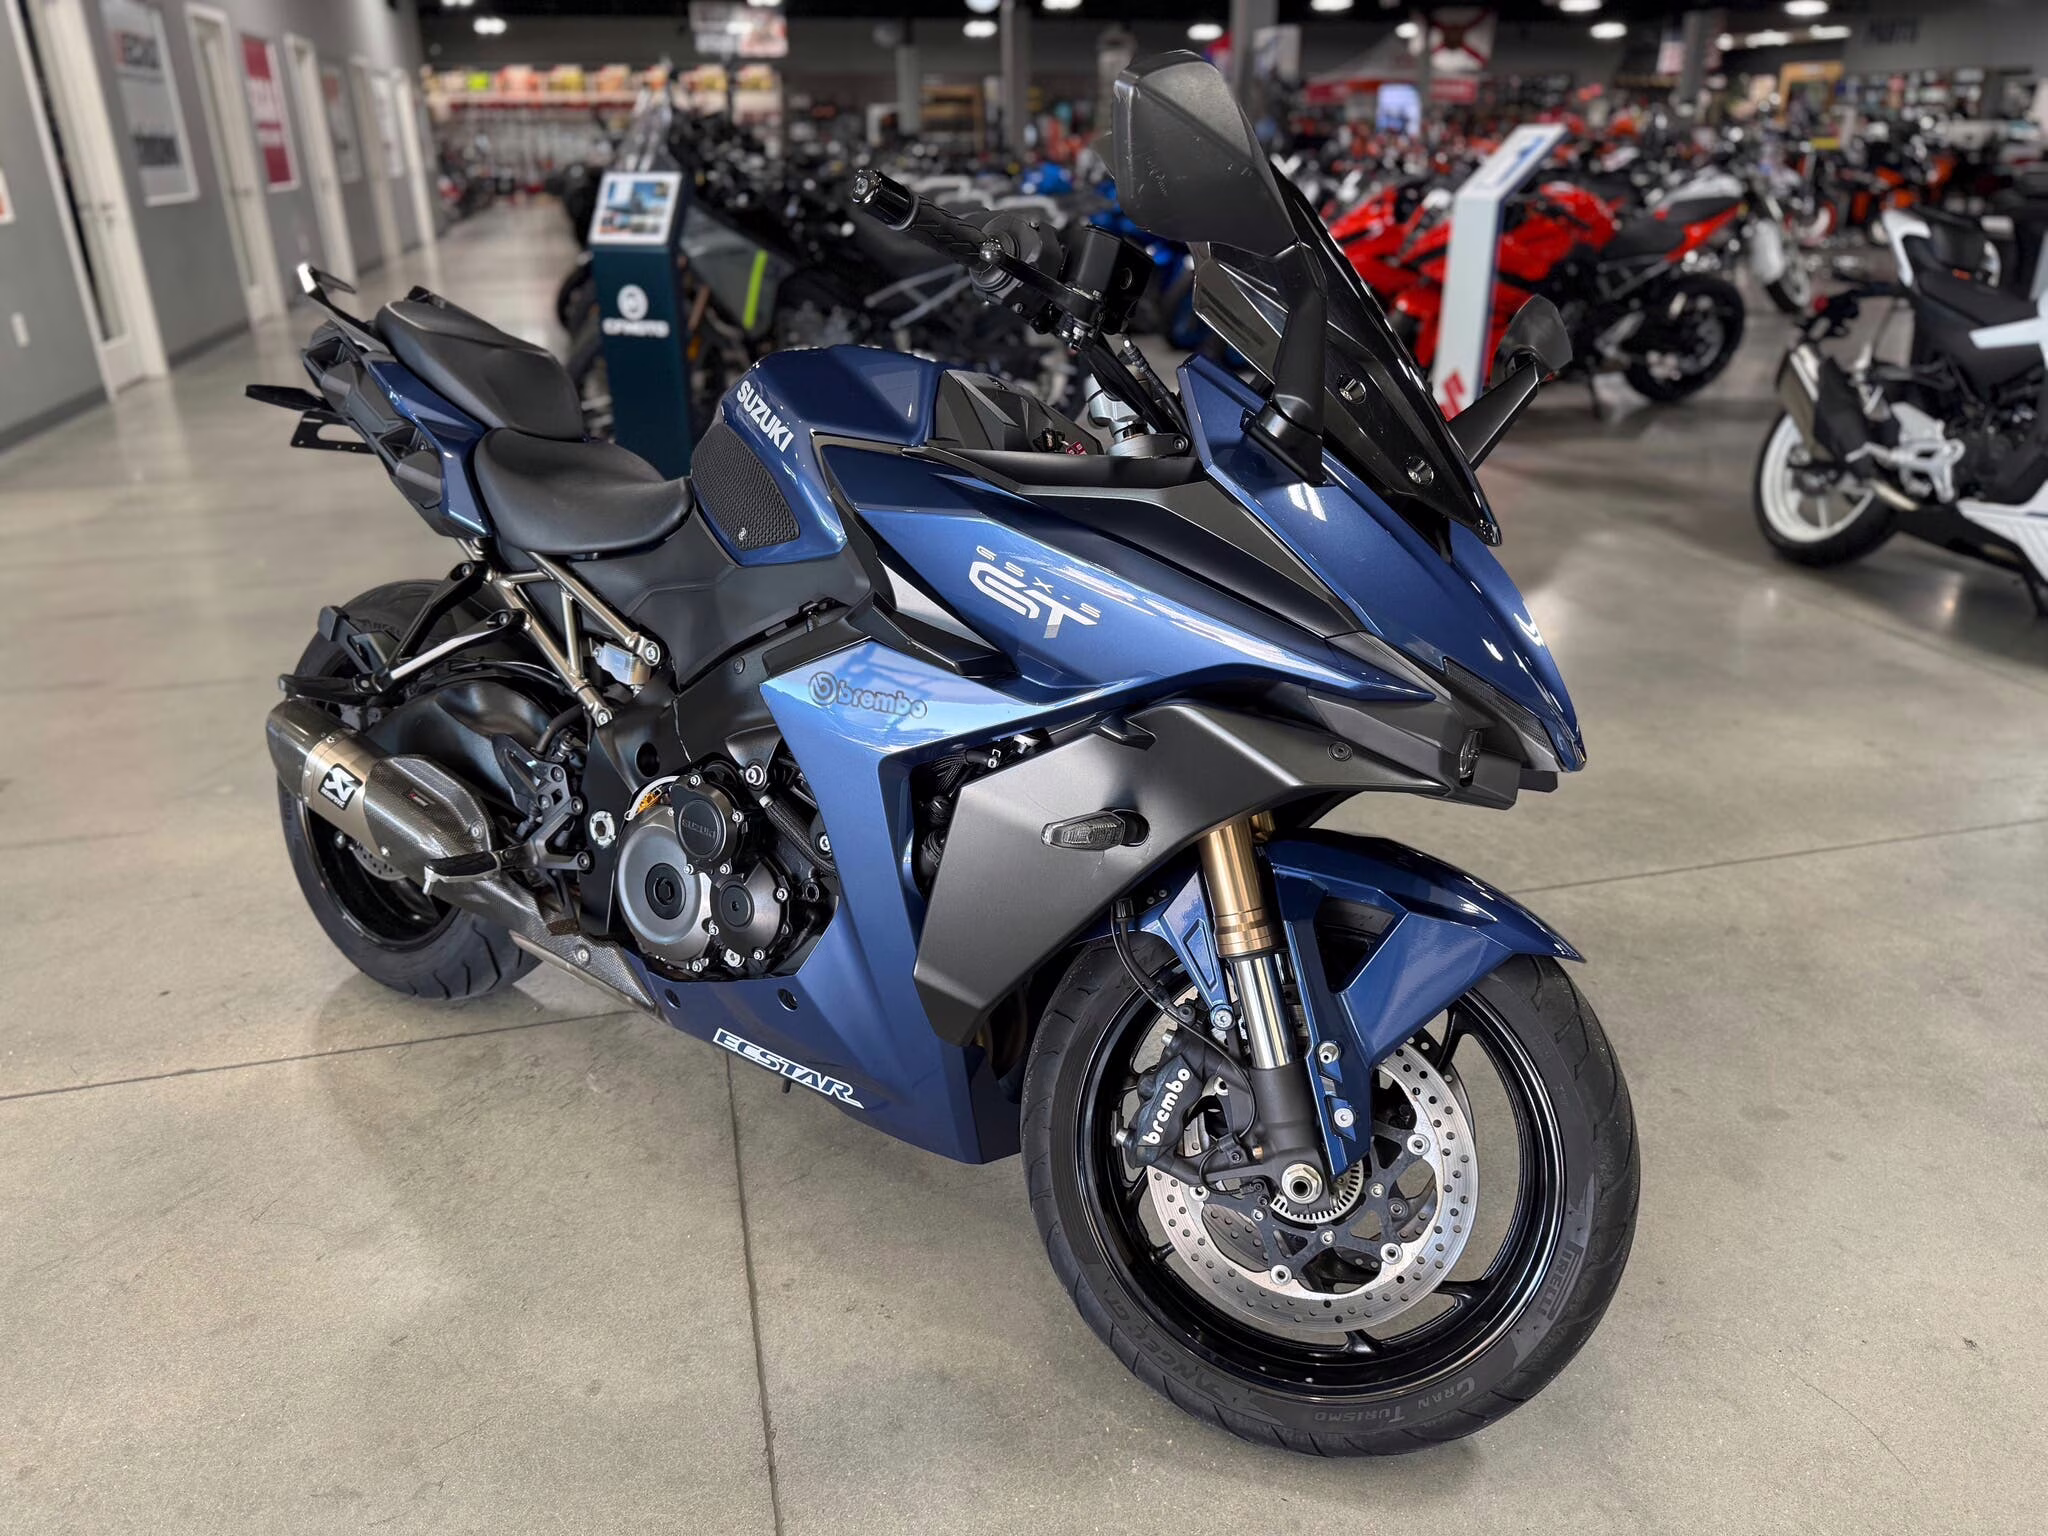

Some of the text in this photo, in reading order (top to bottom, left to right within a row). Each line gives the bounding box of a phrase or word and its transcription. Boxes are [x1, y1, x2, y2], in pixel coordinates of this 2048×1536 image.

[736, 380, 795, 453] SUZUKI
[837, 680, 928, 720] brembo
[712, 1027, 865, 1110] ECSTAR
[1142, 1068, 1191, 1145] brembo
[1313, 1405, 1406, 1424] TURISMO
[1417, 1376, 1476, 1409] GRAN
